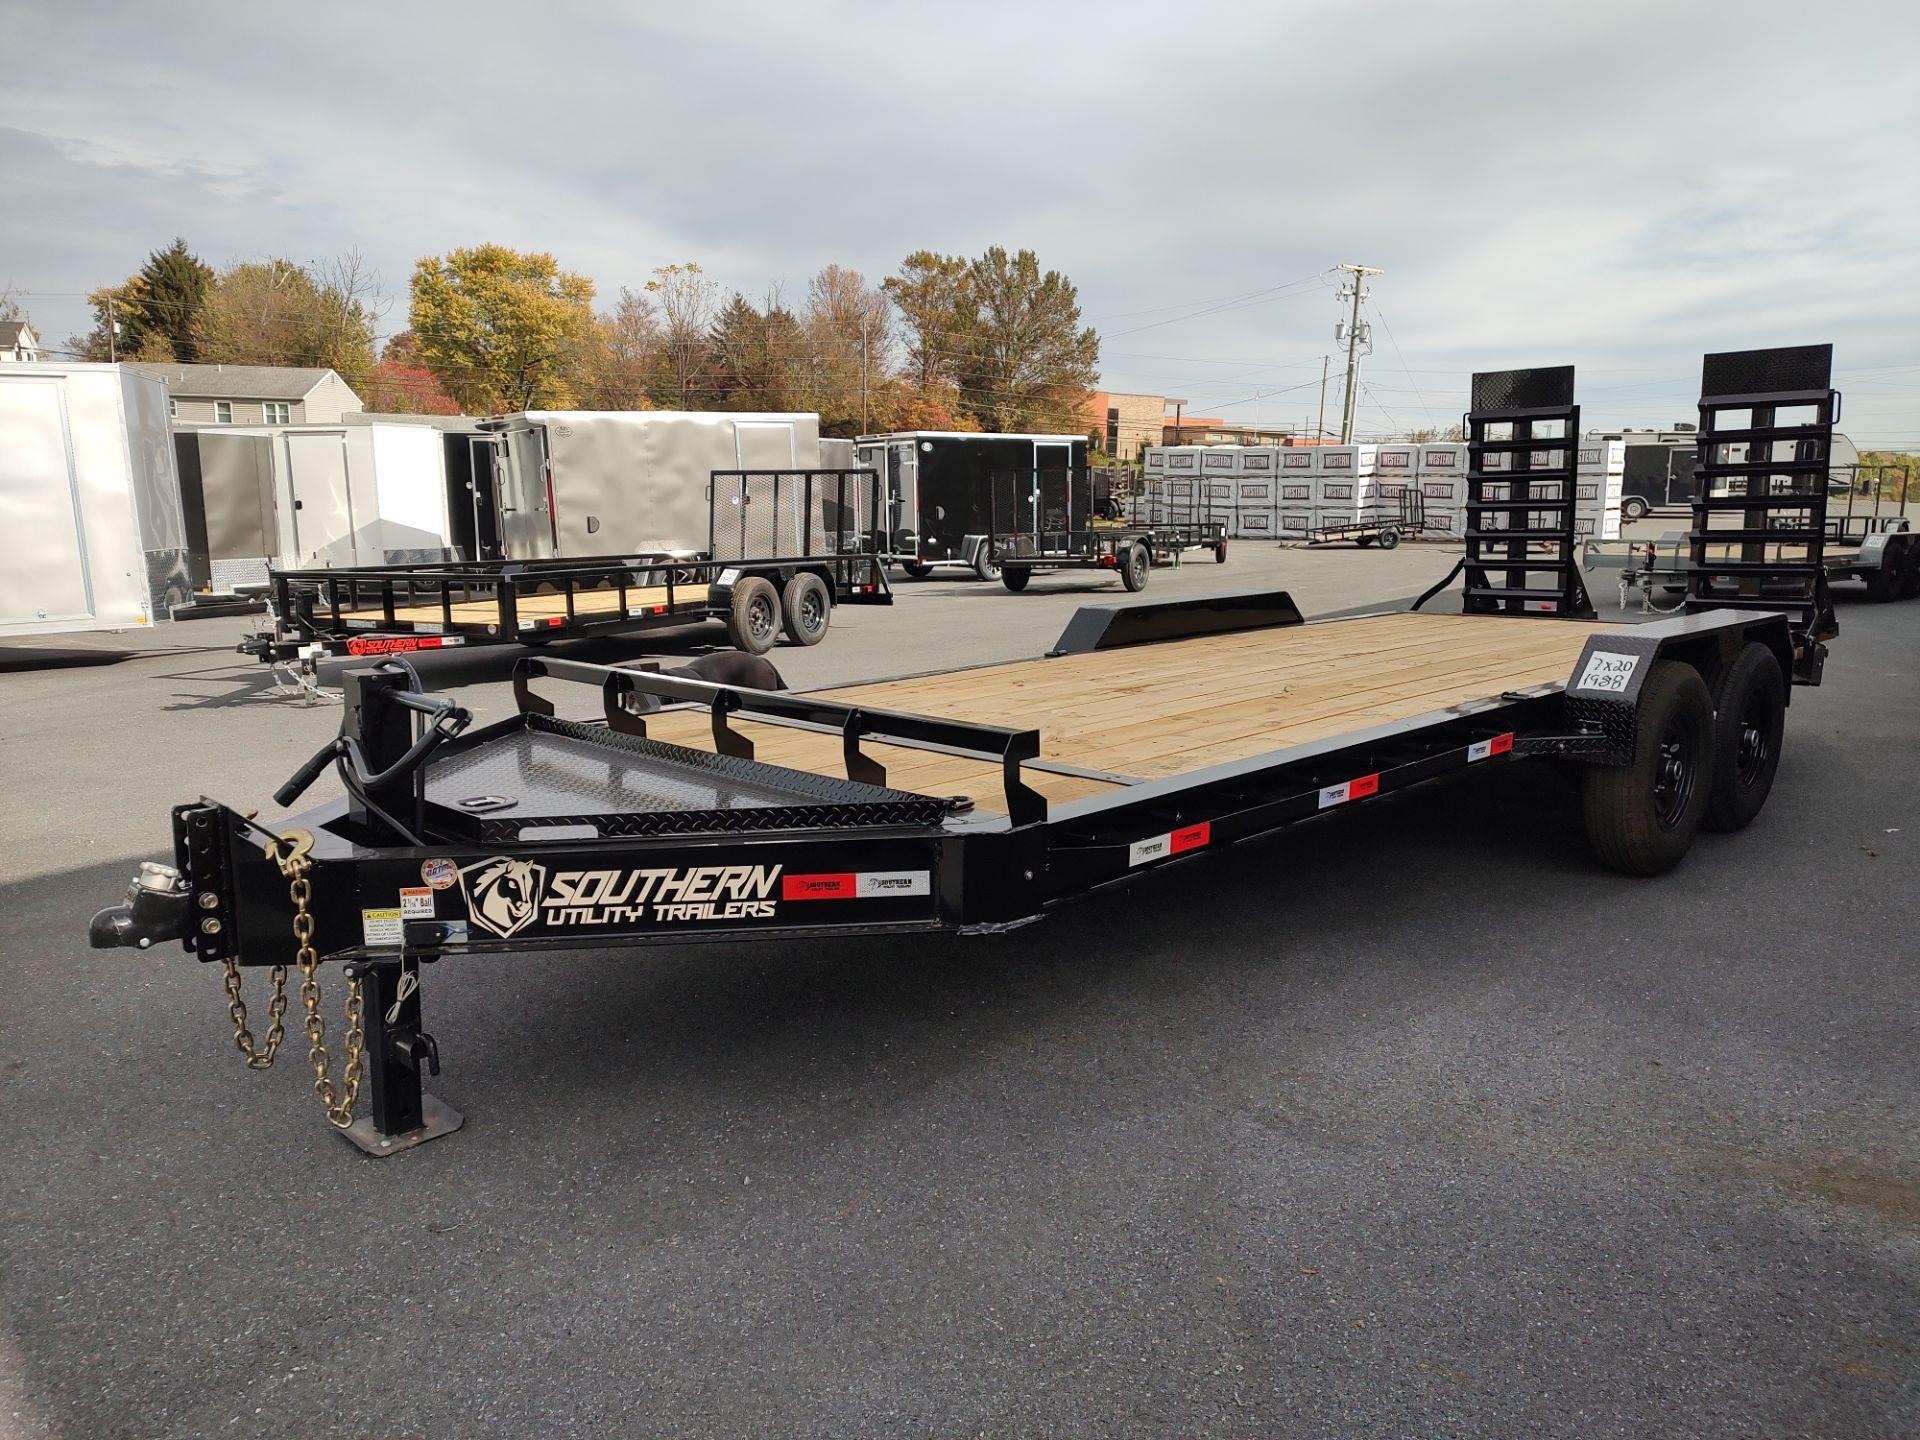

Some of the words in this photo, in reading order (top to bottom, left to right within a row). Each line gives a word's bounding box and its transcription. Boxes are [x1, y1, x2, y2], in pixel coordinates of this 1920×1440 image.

[1206, 455, 1232, 467] WESTERN
[1245, 456, 1268, 468] WESTERN
[1285, 454, 1309, 467] WESTERN
[1325, 454, 1350, 467] WESTERN
[1382, 453, 1409, 466] WESTERN
[1427, 453, 1455, 466] WESTERN
[1578, 450, 1600, 463] STERN
[1242, 486, 1267, 497] WESTERN
[1284, 487, 1308, 498] WESTERN
[1325, 485, 1351, 497] WESTERN
[1425, 484, 1453, 497] WESTERN
[1245, 516, 1267, 528] WESTERN
[1284, 517, 1308, 529] WESTERN
[366, 638, 417, 649] SOUTHERN
[540, 864, 783, 907] SOUTHERN
[420, 897, 432, 908] Ball
[547, 905, 643, 926] UTILITY
[653, 901, 777, 922] TRAILERS
